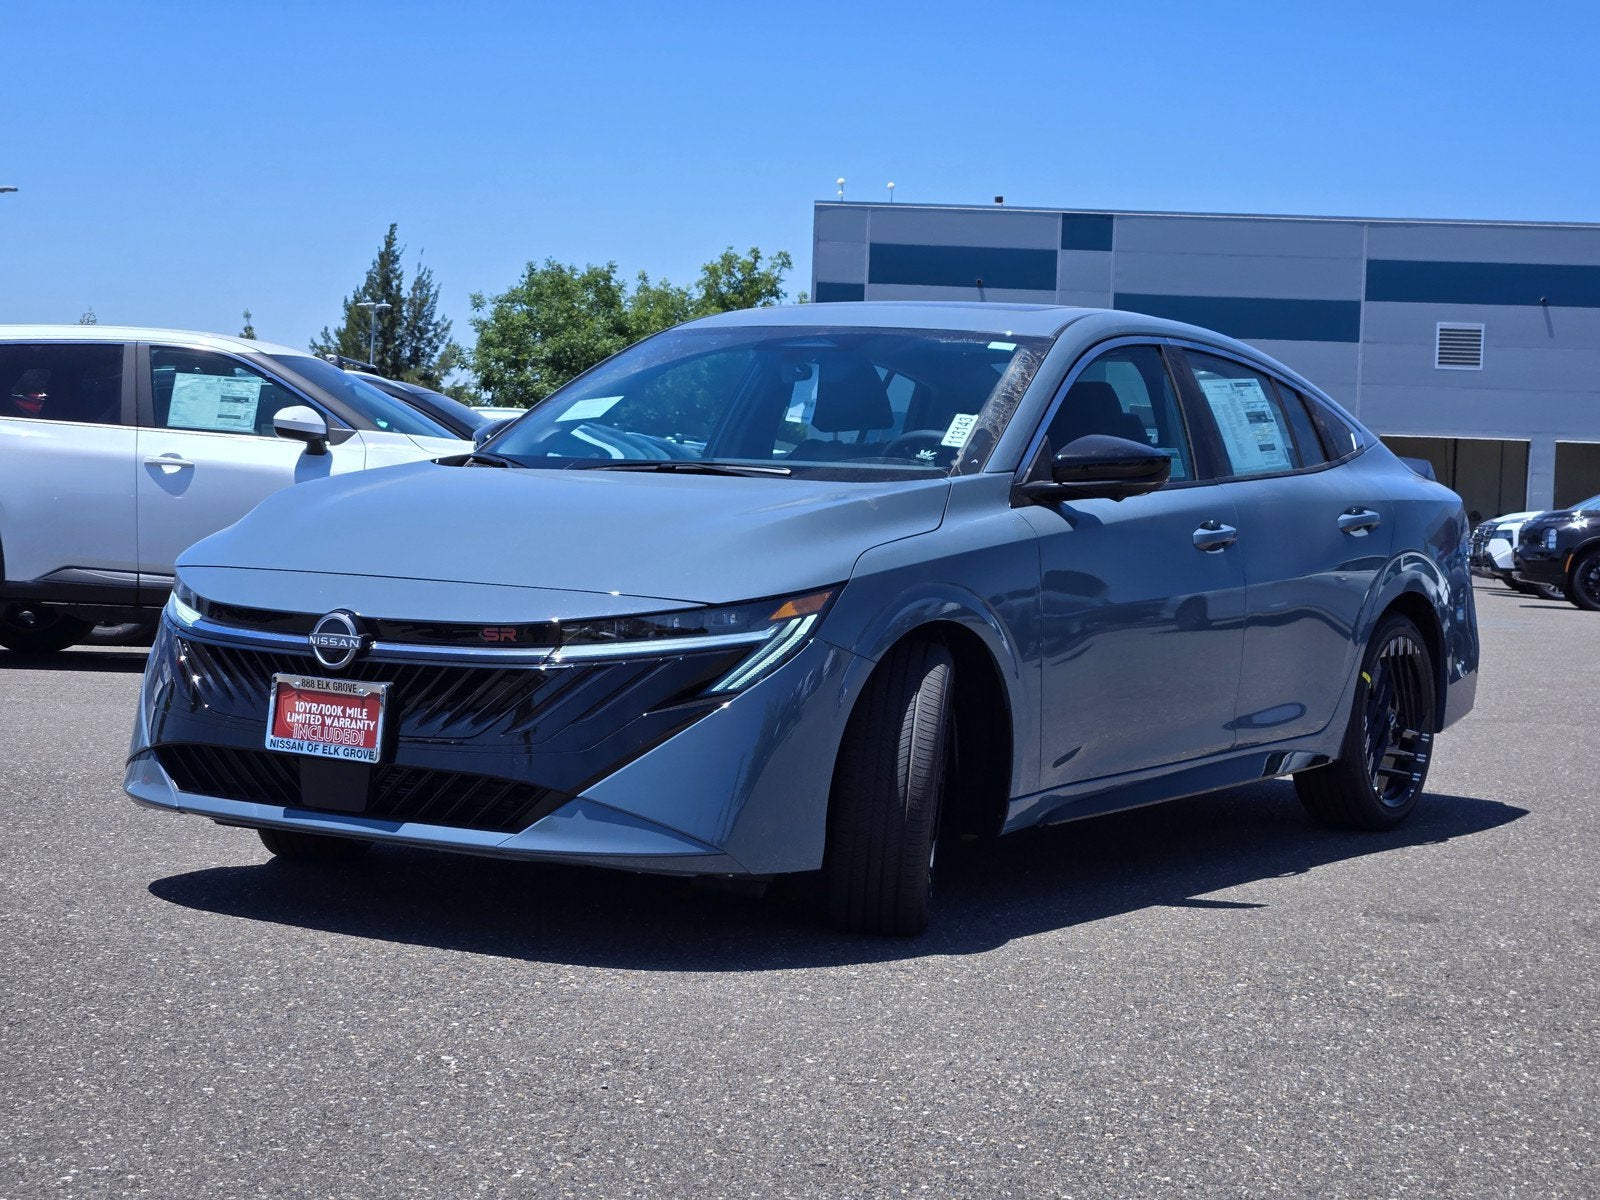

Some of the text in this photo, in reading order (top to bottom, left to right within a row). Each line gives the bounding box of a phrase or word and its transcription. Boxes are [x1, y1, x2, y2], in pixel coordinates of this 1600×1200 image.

[948, 417, 973, 444] 113143
[309, 636, 360, 648] NISSAN
[483, 627, 517, 641] SR
[301, 678, 357, 693] 888 ELK GROVE
[295, 701, 368, 719] 10YR/100K MILE
[287, 712, 376, 731] LIMITED WARRANTY
[292, 724, 365, 746] INCLUDED!
[269, 739, 374, 760] NISSAN OF ELK GROVE
